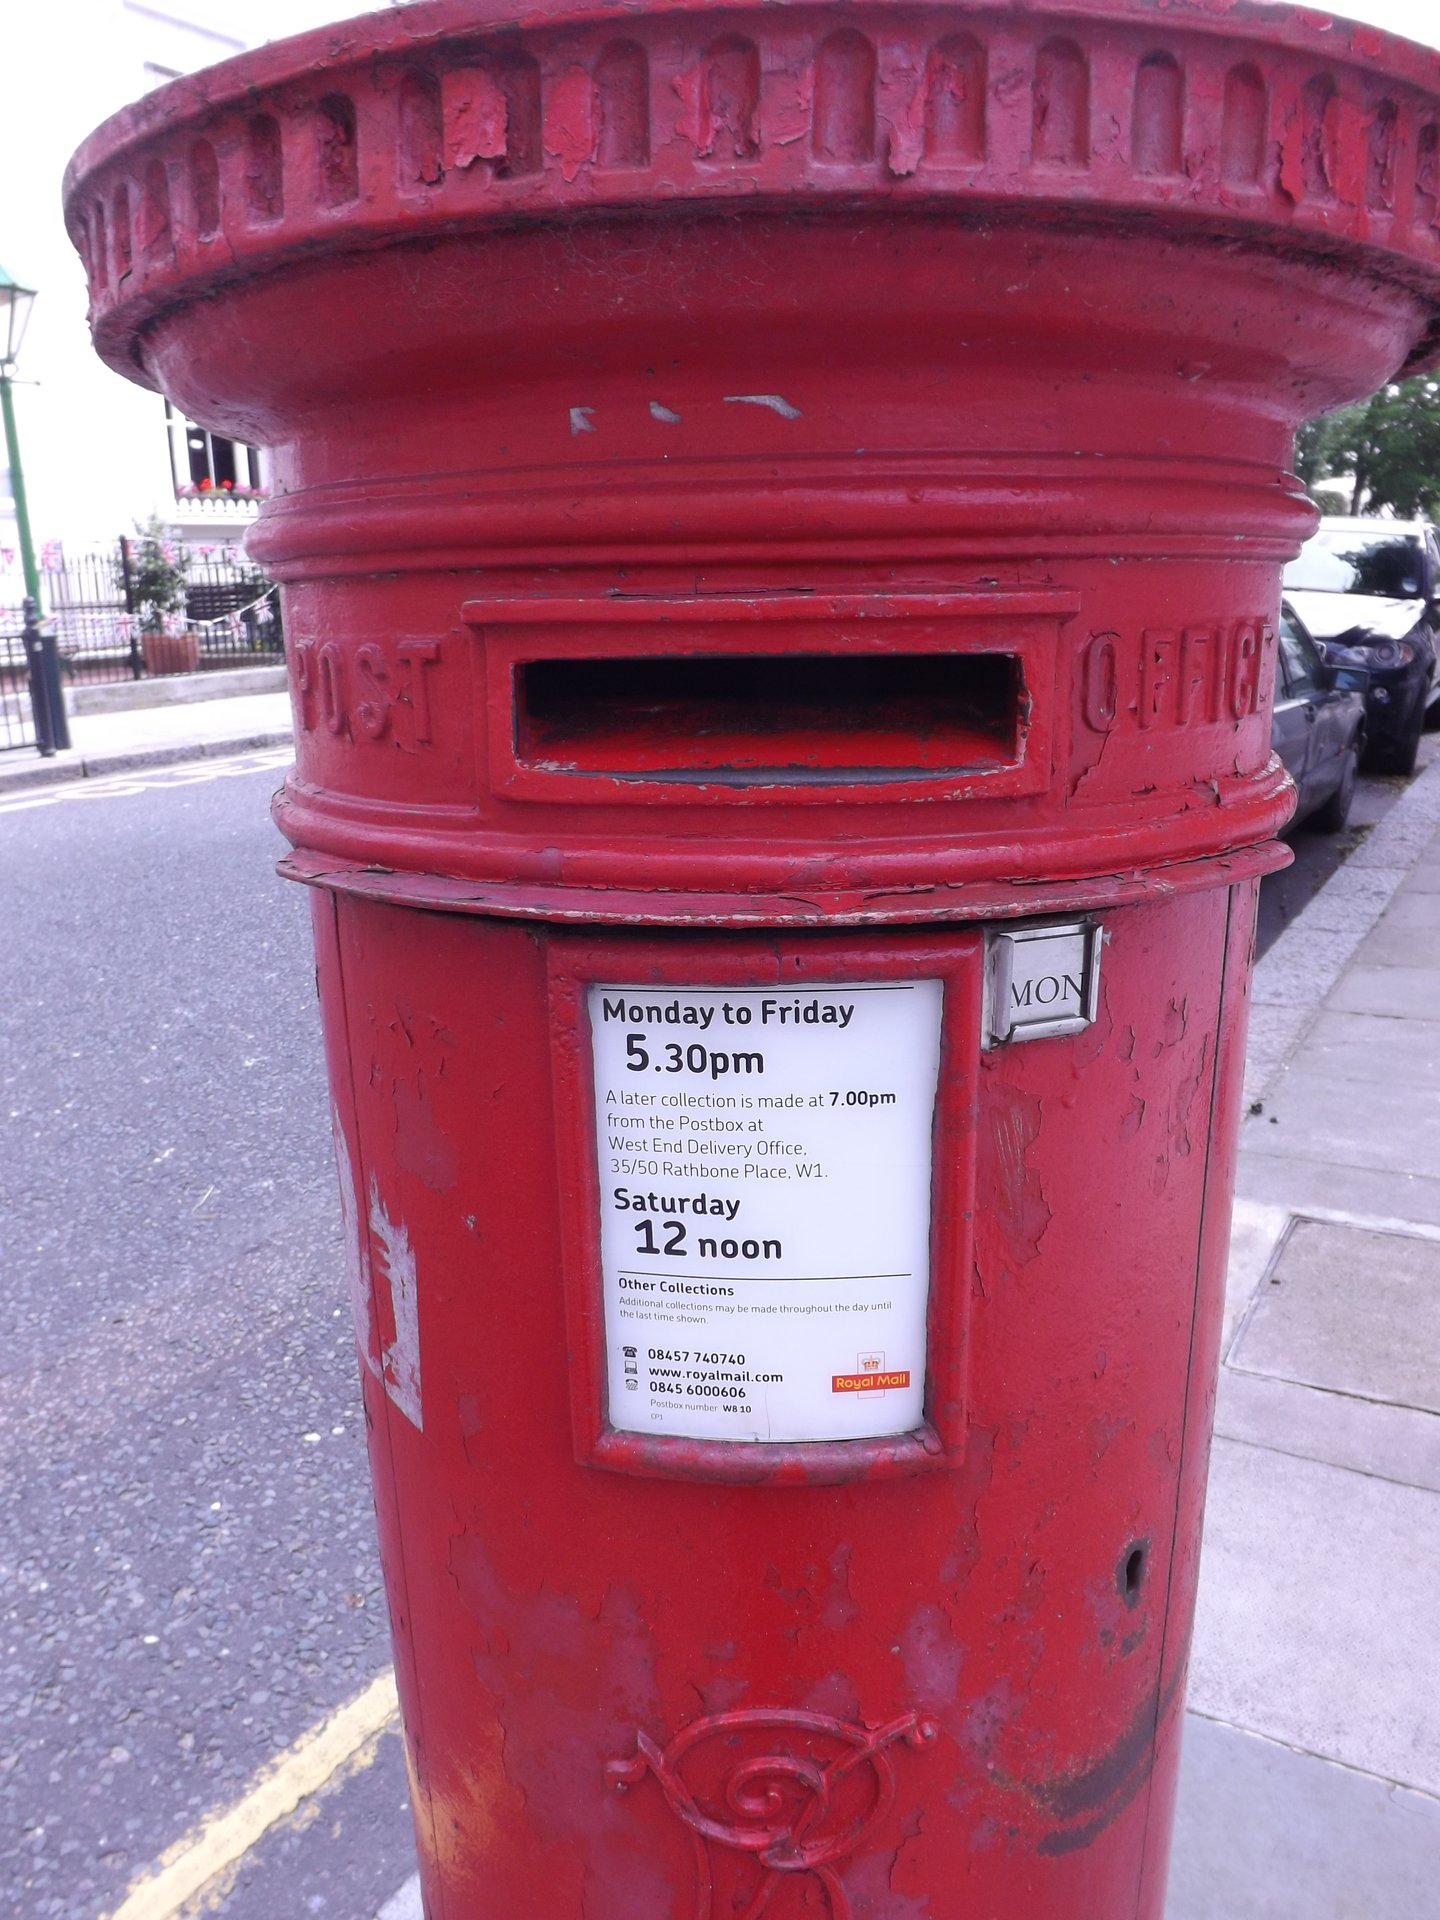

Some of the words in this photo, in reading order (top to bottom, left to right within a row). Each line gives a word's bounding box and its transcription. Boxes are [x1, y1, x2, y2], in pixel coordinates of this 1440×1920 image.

[295, 634, 441, 746] POST
[1011, 972, 1088, 1009] MON
[602, 998, 714, 1029] Monday
[722, 1002, 752, 1025] to
[761, 1000, 855, 1028] Friday
[625, 1033, 765, 1080] 5.30pm
[606, 1089, 617, 1104] A
[620, 1090, 657, 1106] later
[661, 1092, 736, 1108] collection
[741, 1094, 753, 1108] is
[758, 1093, 804, 1108] made
[808, 1094, 824, 1108] at
[829, 1091, 896, 1108] 7.00pm
[607, 1113, 645, 1128] from
[649, 1115, 675, 1130] the
[679, 1115, 744, 1132] Postbox
[748, 1119, 764, 1132] at
[608, 1136, 649, 1152] West
[653, 1138, 683, 1154] End
[688, 1139, 752, 1158] Delivery
[757, 1140, 807, 1156] Office,
[610, 1158, 658, 1175] 35/50
[663, 1161, 739, 1178] Rathbone
[744, 1164, 791, 1179] Place,
[795, 1163, 828, 1178] W1.
[614, 1188, 741, 1220] Saturday
[634, 1219, 687, 1257] 12
[698, 1236, 783, 1260] noon
[618, 1277, 656, 1291] Other
[659, 1281, 735, 1296] Collections
[619, 1297, 664, 1309] Additional
[665, 1300, 713, 1312] collections
[715, 1304, 736, 1315] may
[737, 1304, 749, 1313] be
[751, 1304, 778, 1314] made
[780, 1304, 833, 1315] throughout
[834, 1303, 850, 1312] the
[852, 1303, 869, 1313] day
[871, 1301, 892, 1311] until
[620, 1309, 634, 1319] the
[636, 1310, 652, 1320] last
[654, 1312, 675, 1322] time
[676, 1314, 709, 1324] shown.
[648, 1348, 689, 1362] 08457
[694, 1352, 746, 1365] 740740
[649, 1367, 784, 1383] www.royalmail.com
[836, 1376, 874, 1390] Royal
[877, 1373, 907, 1386] Mail
[649, 1381, 683, 1395] 0845
[686, 1384, 747, 1398] 6000606
[650, 1399, 683, 1409] Postbox
[685, 1403, 718, 1412] number
